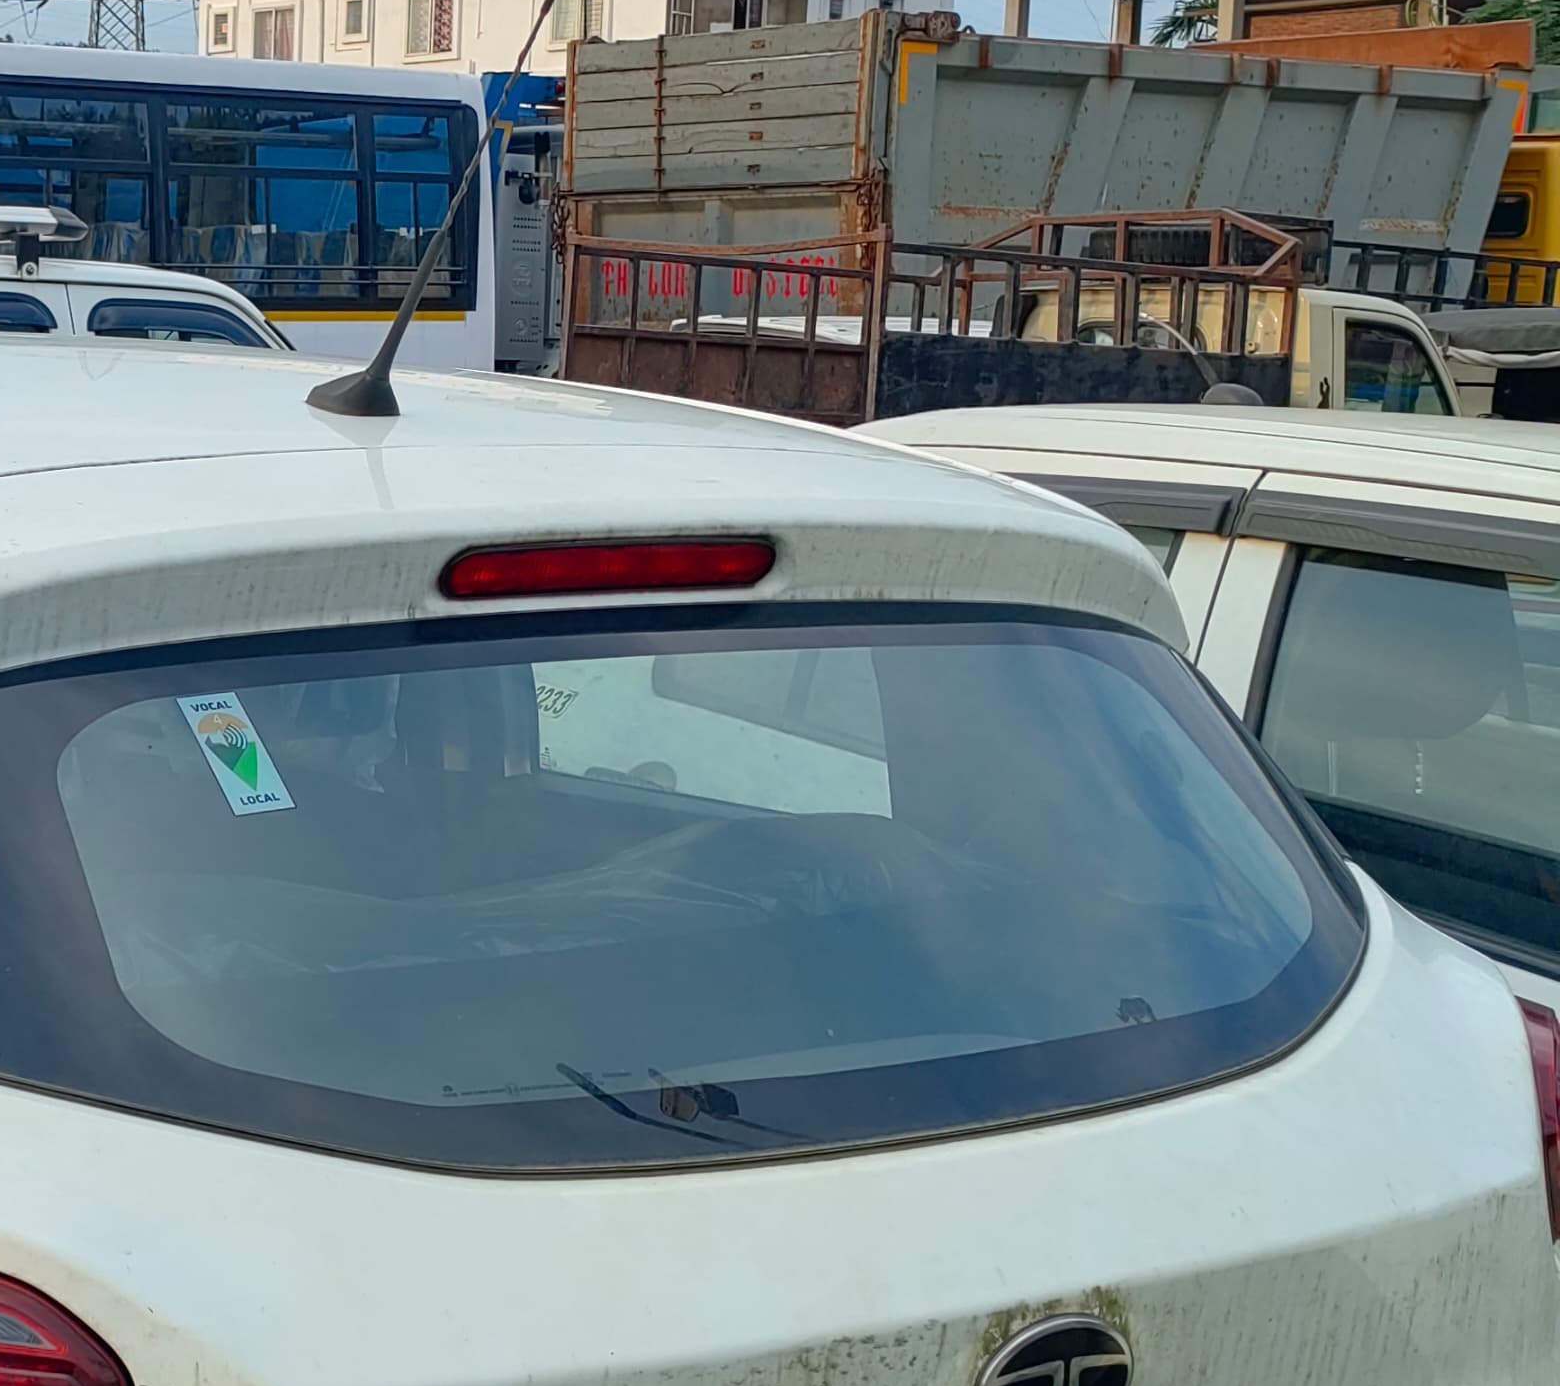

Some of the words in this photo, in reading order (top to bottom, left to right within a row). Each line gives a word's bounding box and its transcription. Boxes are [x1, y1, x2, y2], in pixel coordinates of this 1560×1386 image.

[601, 260, 629, 297] TH
[648, 262, 687, 298] LOR
[190, 700, 232, 713] VOCAL
[239, 792, 280, 806] LOCAL
